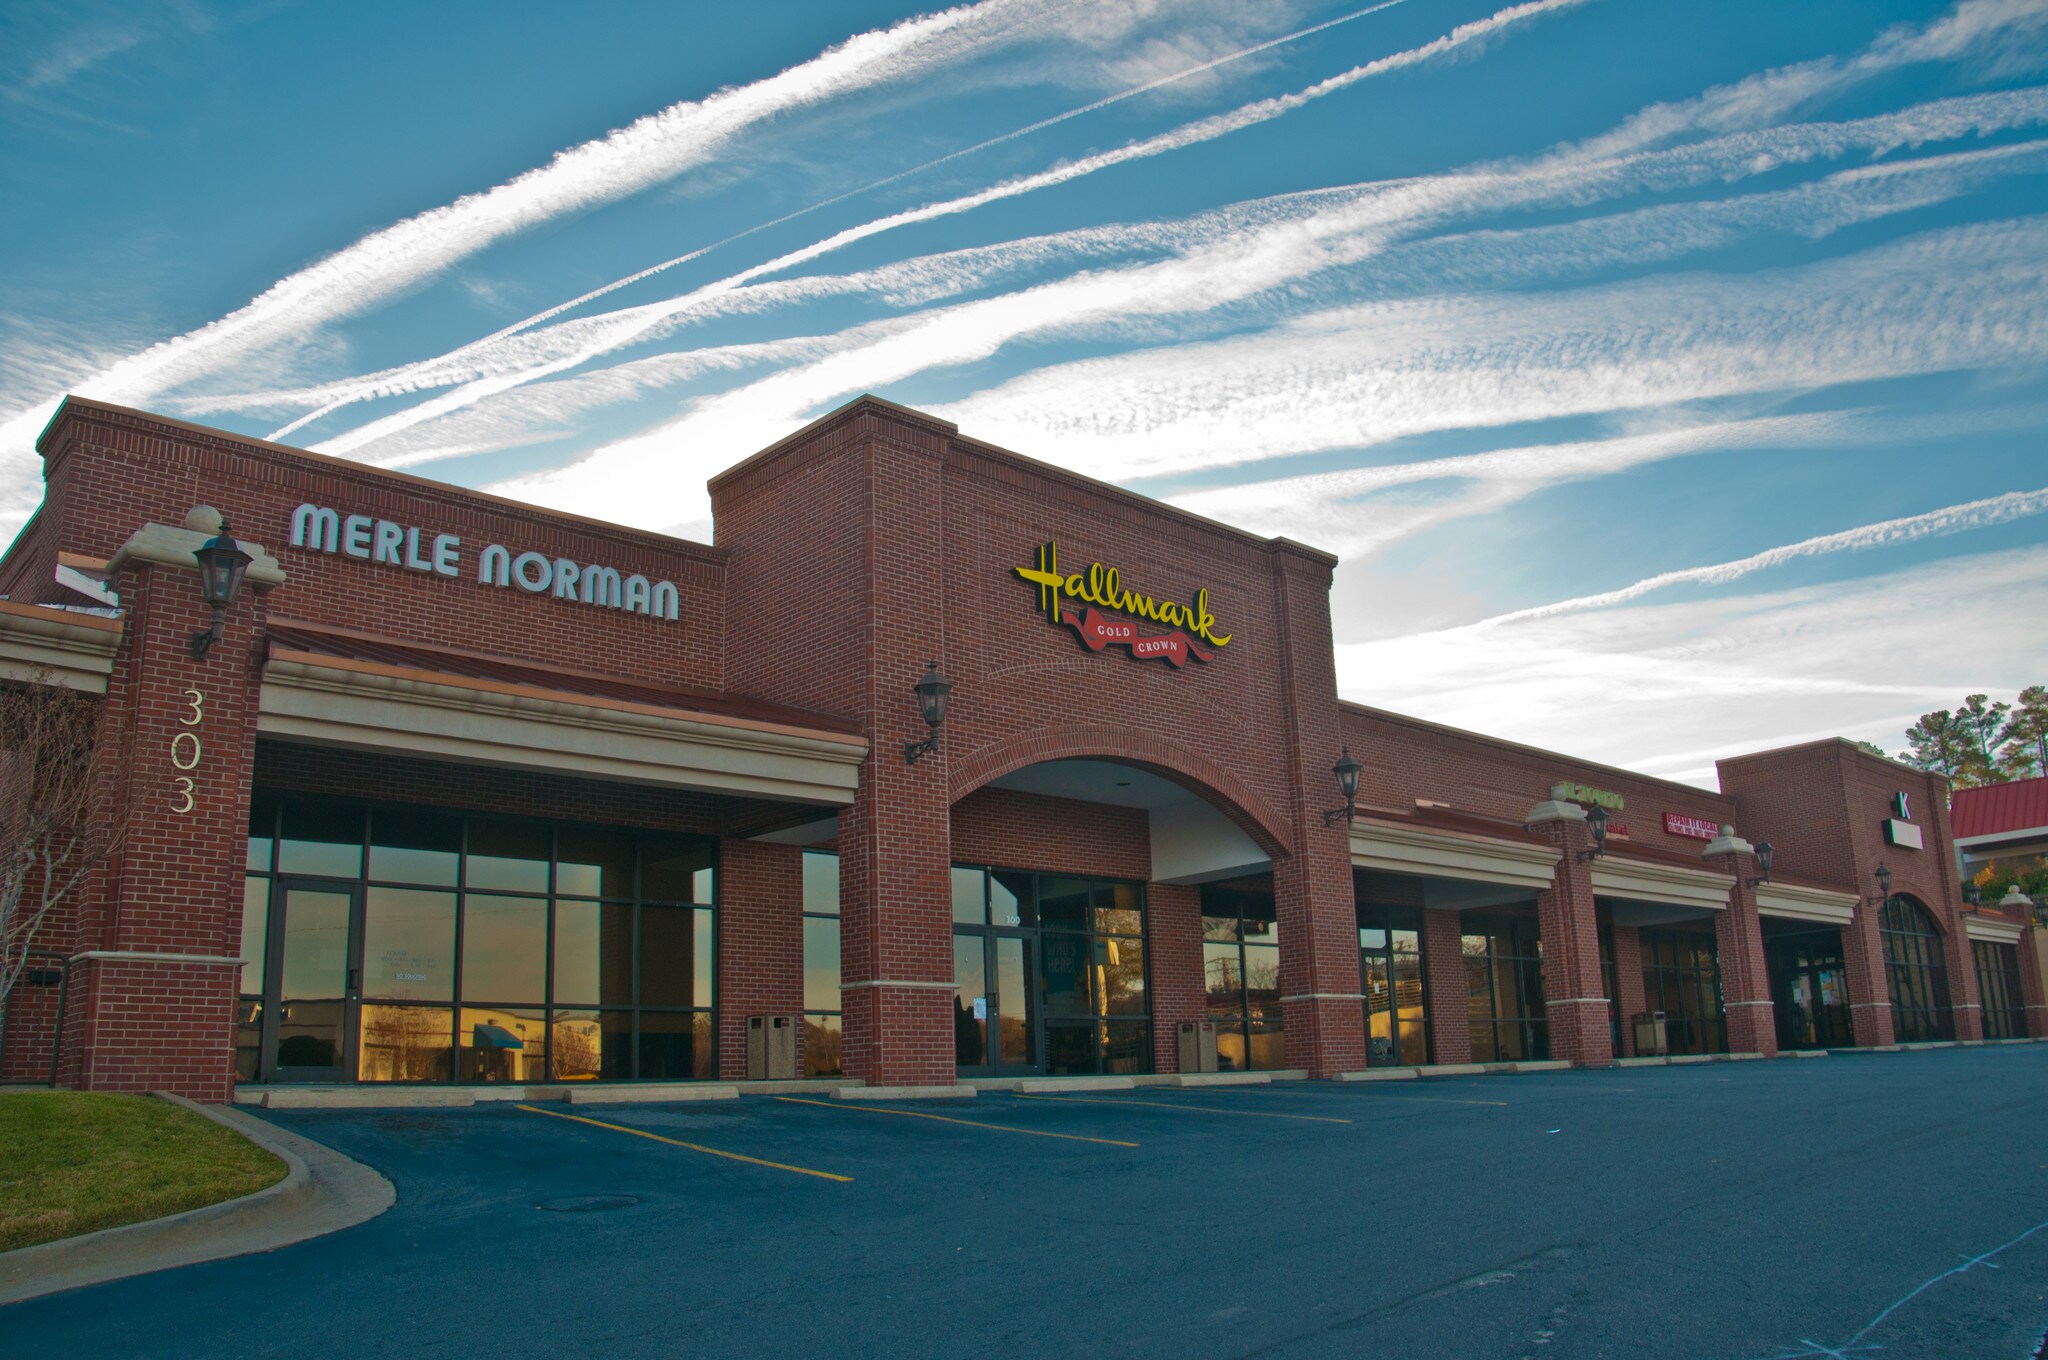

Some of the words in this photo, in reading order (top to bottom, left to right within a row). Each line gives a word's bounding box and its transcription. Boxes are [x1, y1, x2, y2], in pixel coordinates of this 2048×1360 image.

[289, 503, 461, 578] MERLE
[477, 544, 679, 622] NORMAN
[1015, 540, 1233, 647] Hallmark
[1097, 625, 1131, 637] GOLD
[1138, 640, 1178, 653] CROWN
[171, 689, 203, 813] 303
[1898, 791, 1911, 820] K
[1006, 915, 1021, 925] 300
